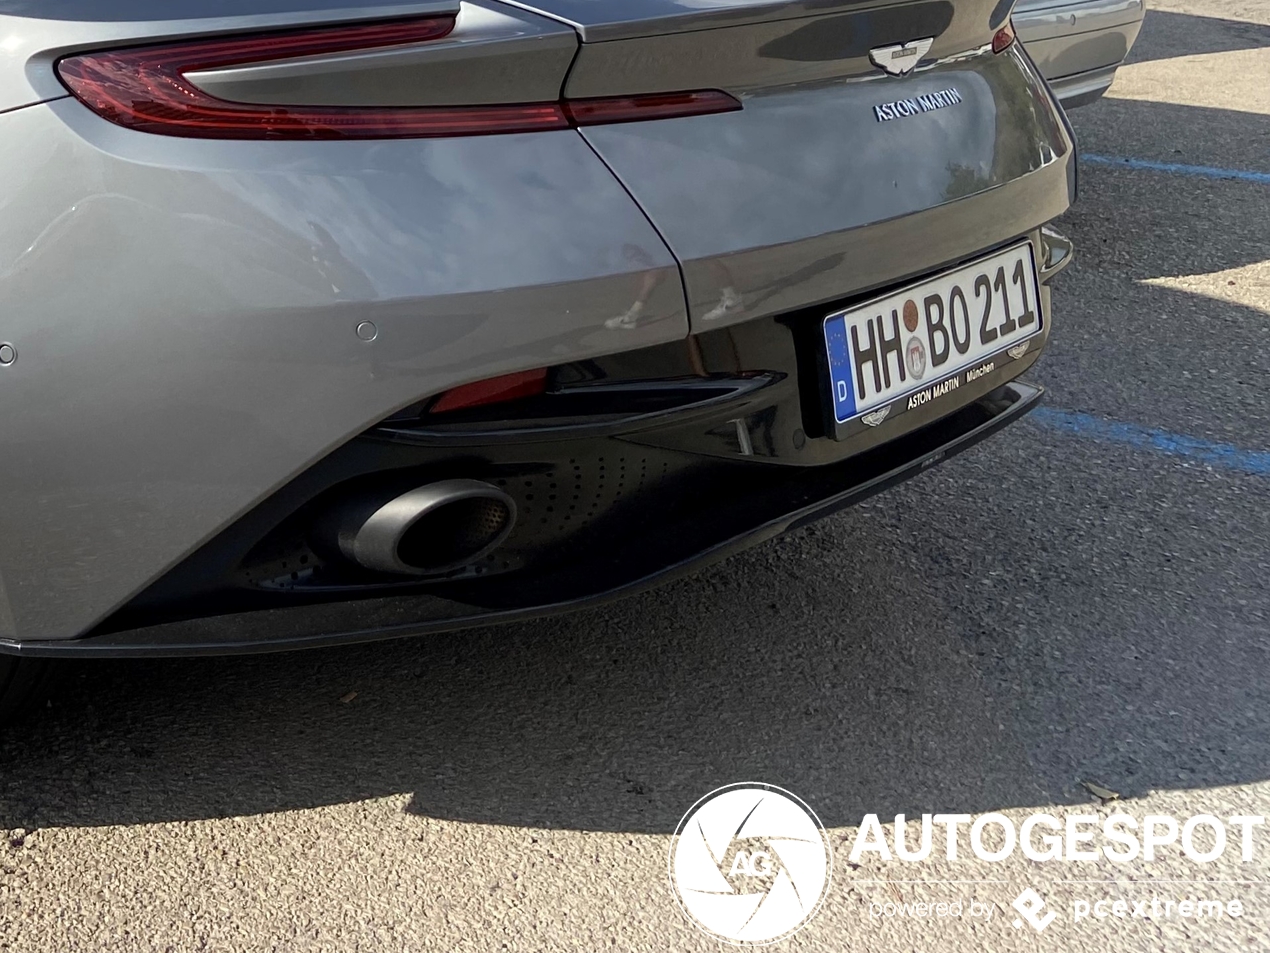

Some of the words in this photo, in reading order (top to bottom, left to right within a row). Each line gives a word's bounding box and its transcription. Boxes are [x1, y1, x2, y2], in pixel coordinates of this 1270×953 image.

[873, 99, 920, 122] ASTON
[916, 88, 962, 112] MARTIN
[850, 309, 906, 400] HH
[974, 258, 1035, 345] 211
[836, 380, 848, 402] D
[907, 389, 931, 410] ASTON
[933, 376, 960, 399] MARTIN
[966, 362, 995, 383] München
